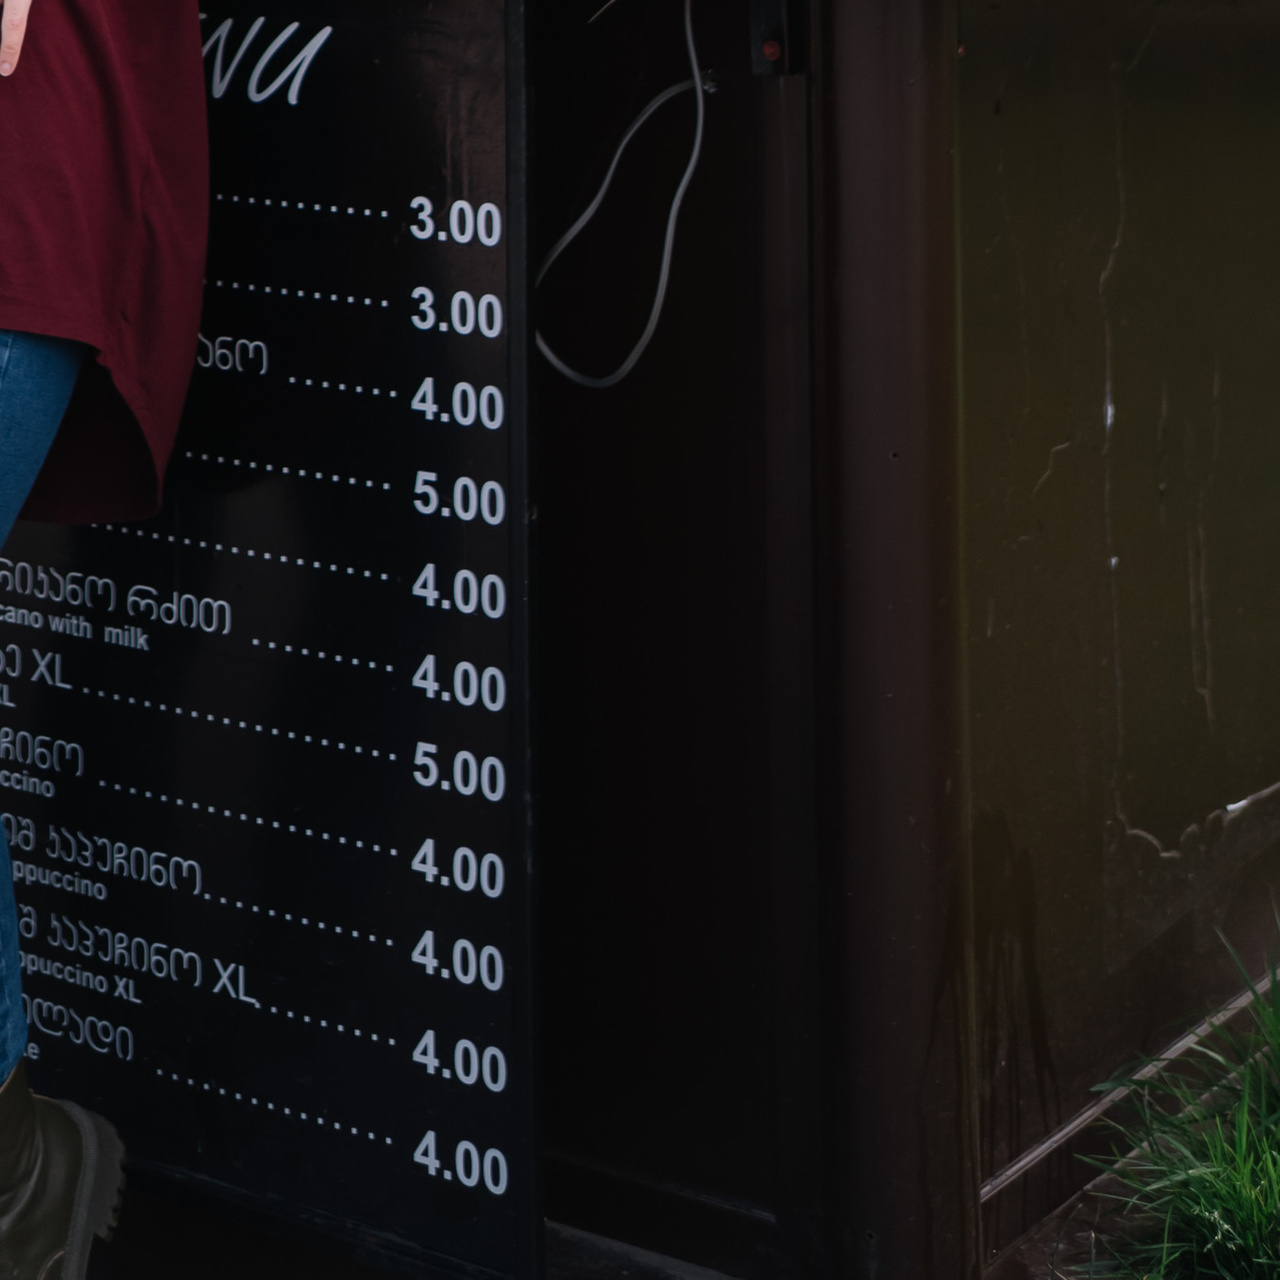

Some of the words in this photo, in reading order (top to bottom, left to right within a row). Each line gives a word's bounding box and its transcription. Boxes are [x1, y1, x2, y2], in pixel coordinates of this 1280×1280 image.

[198, 12, 334, 106] nu
[409, 195, 502, 247] 3.00
[410, 286, 503, 338] 3.00
[411, 377, 504, 430] 4.00
[413, 470, 505, 526] 5.00
[126, 584, 232, 635] რძით
[412, 563, 506, 619] 4.00
[48, 612, 93, 639] with
[104, 625, 150, 651] milk
[30, 648, 74, 690] XL
[412, 654, 506, 712] 4.00
[413, 741, 505, 802] 5.00
[12, 859, 108, 901] ppuccino
[45, 824, 203, 896] კაპუჩინო
[411, 838, 504, 898] 4.00
[46, 912, 203, 988] კაპუჩინო
[212, 957, 258, 1004] XL
[411, 930, 503, 991] 4.00
[112, 974, 143, 1005] XL
[412, 1029, 506, 1092] 4.00
[413, 1130, 508, 1195] 4.00
